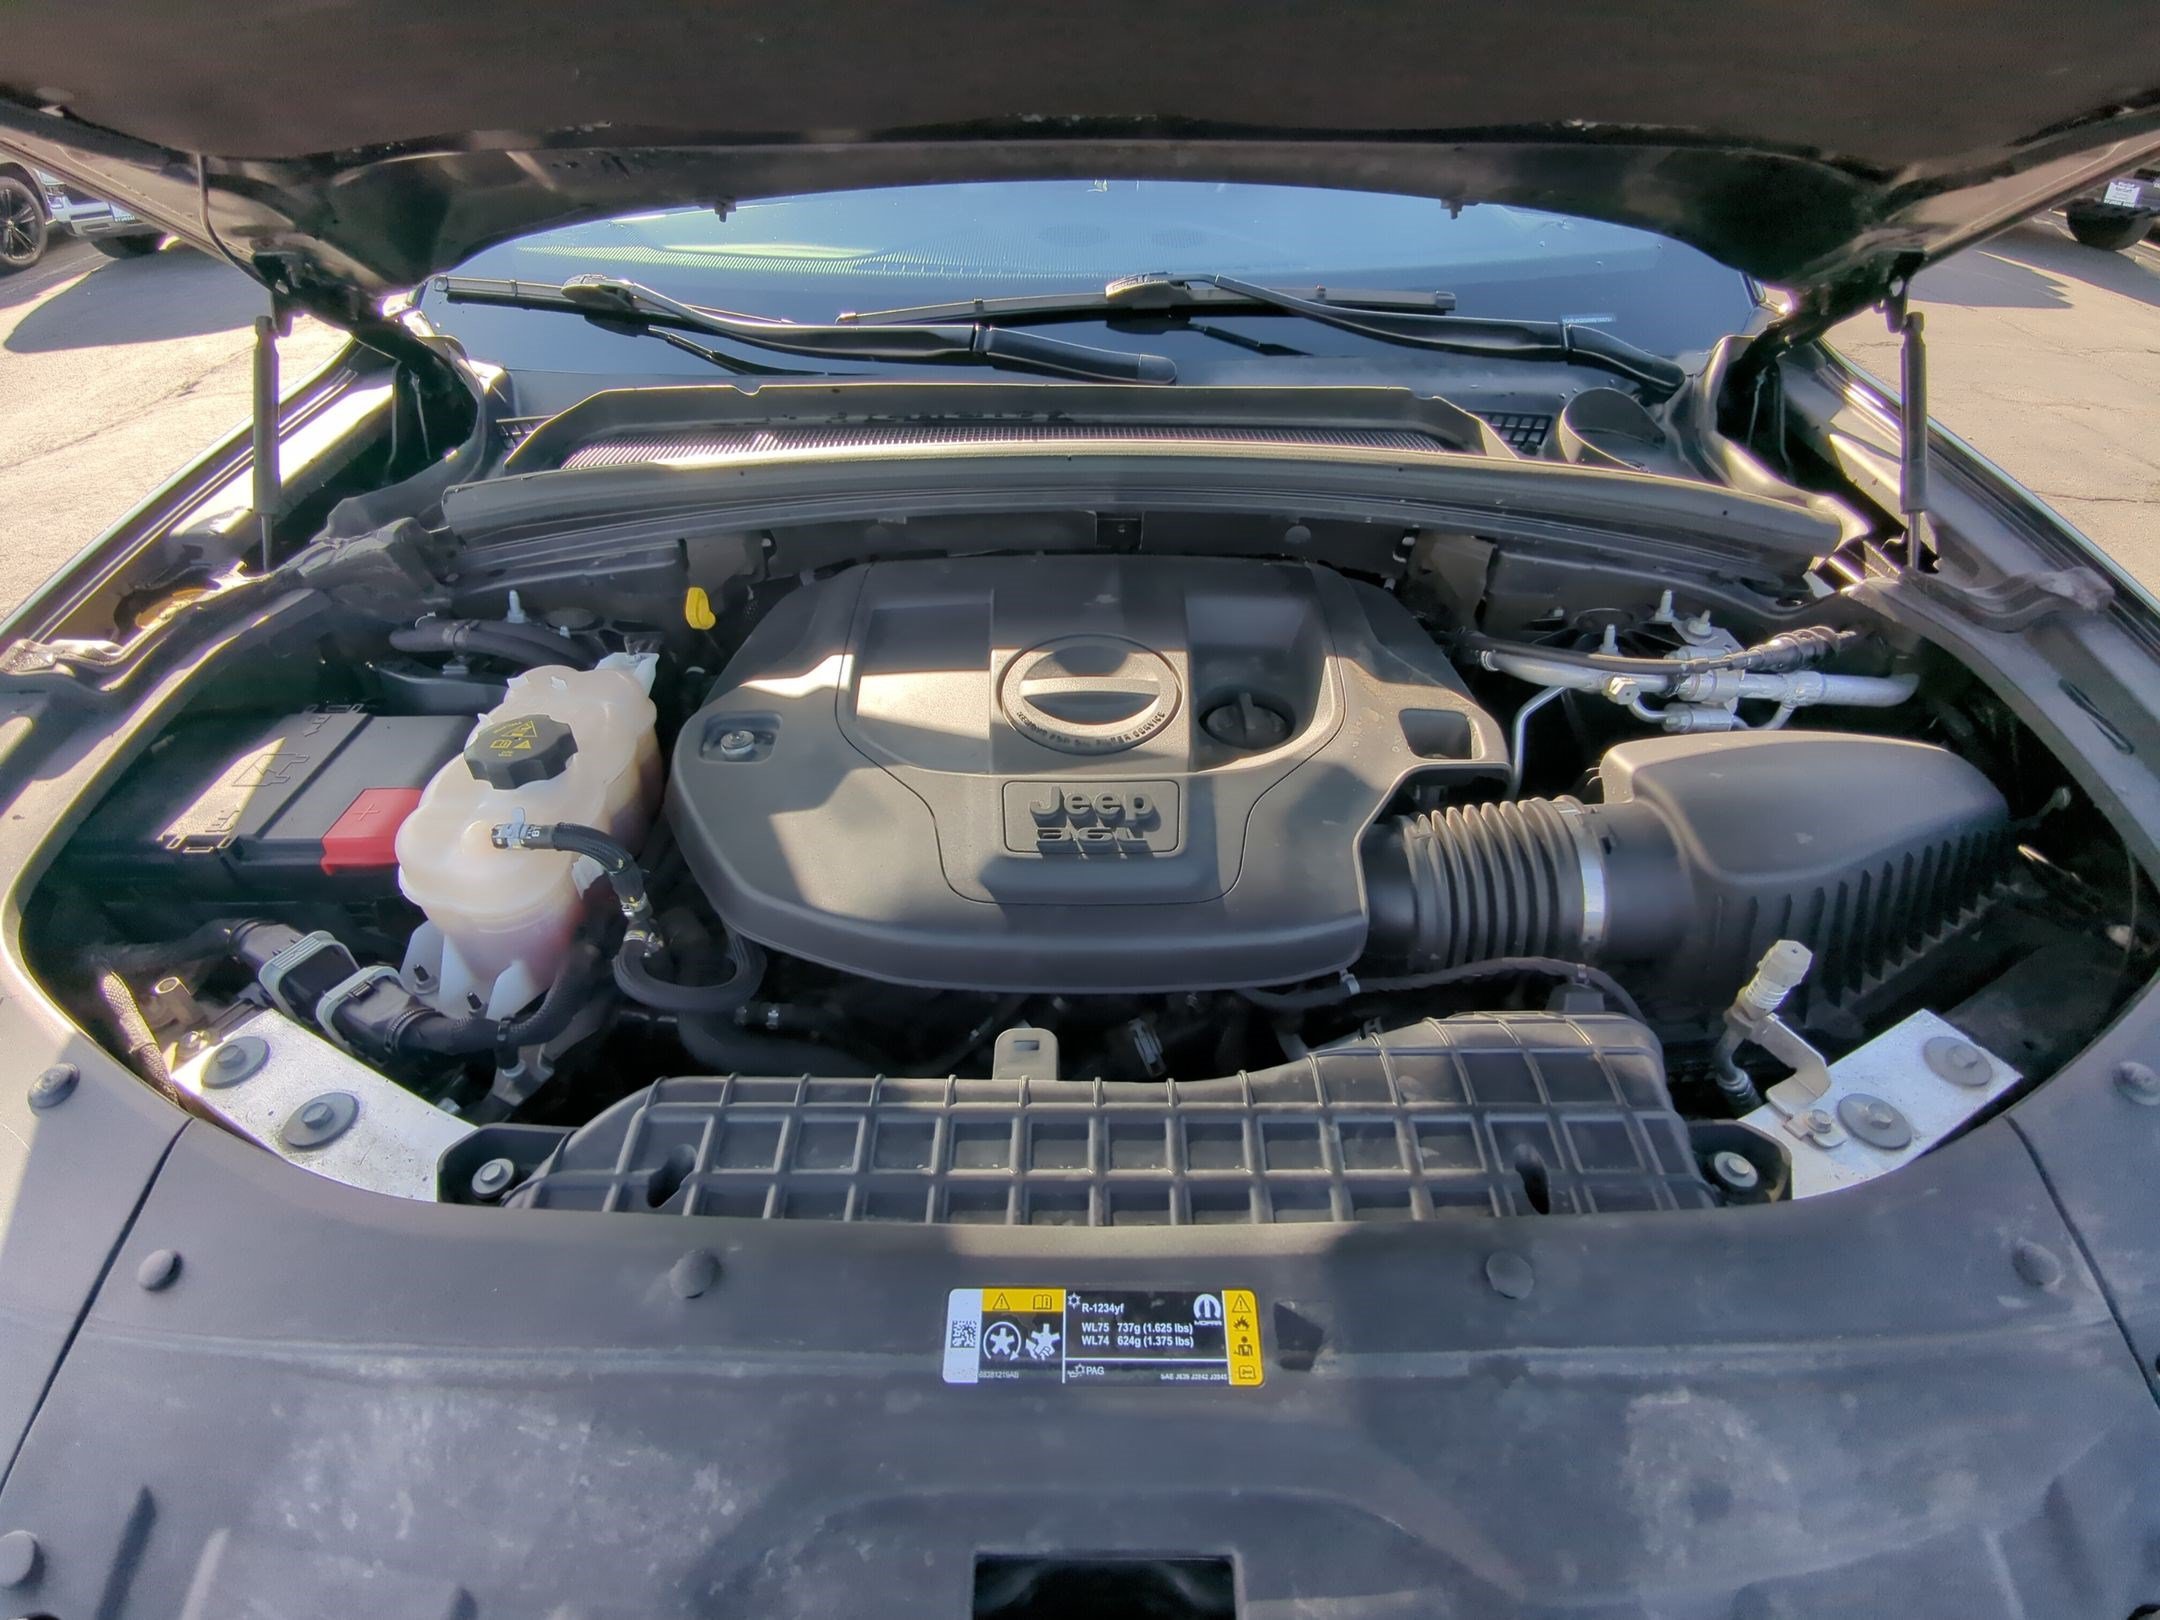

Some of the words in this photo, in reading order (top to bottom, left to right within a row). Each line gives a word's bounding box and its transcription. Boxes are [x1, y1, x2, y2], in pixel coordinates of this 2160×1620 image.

[1030, 786, 1156, 820] Jeep
[1081, 1303, 1125, 1315] R-1234yf
[1081, 1322, 1110, 1333] WL75
[1117, 1323, 1141, 1334] 737g
[1143, 1323, 1172, 1334] (1.625
[1174, 1323, 1194, 1334] lbs)
[1081, 1336, 1110, 1346] WL74
[1117, 1336, 1141, 1347] 624g
[1143, 1336, 1173, 1347] (1.375
[1175, 1336, 1194, 1347] lbs)
[1086, 1367, 1105, 1376] PAG
